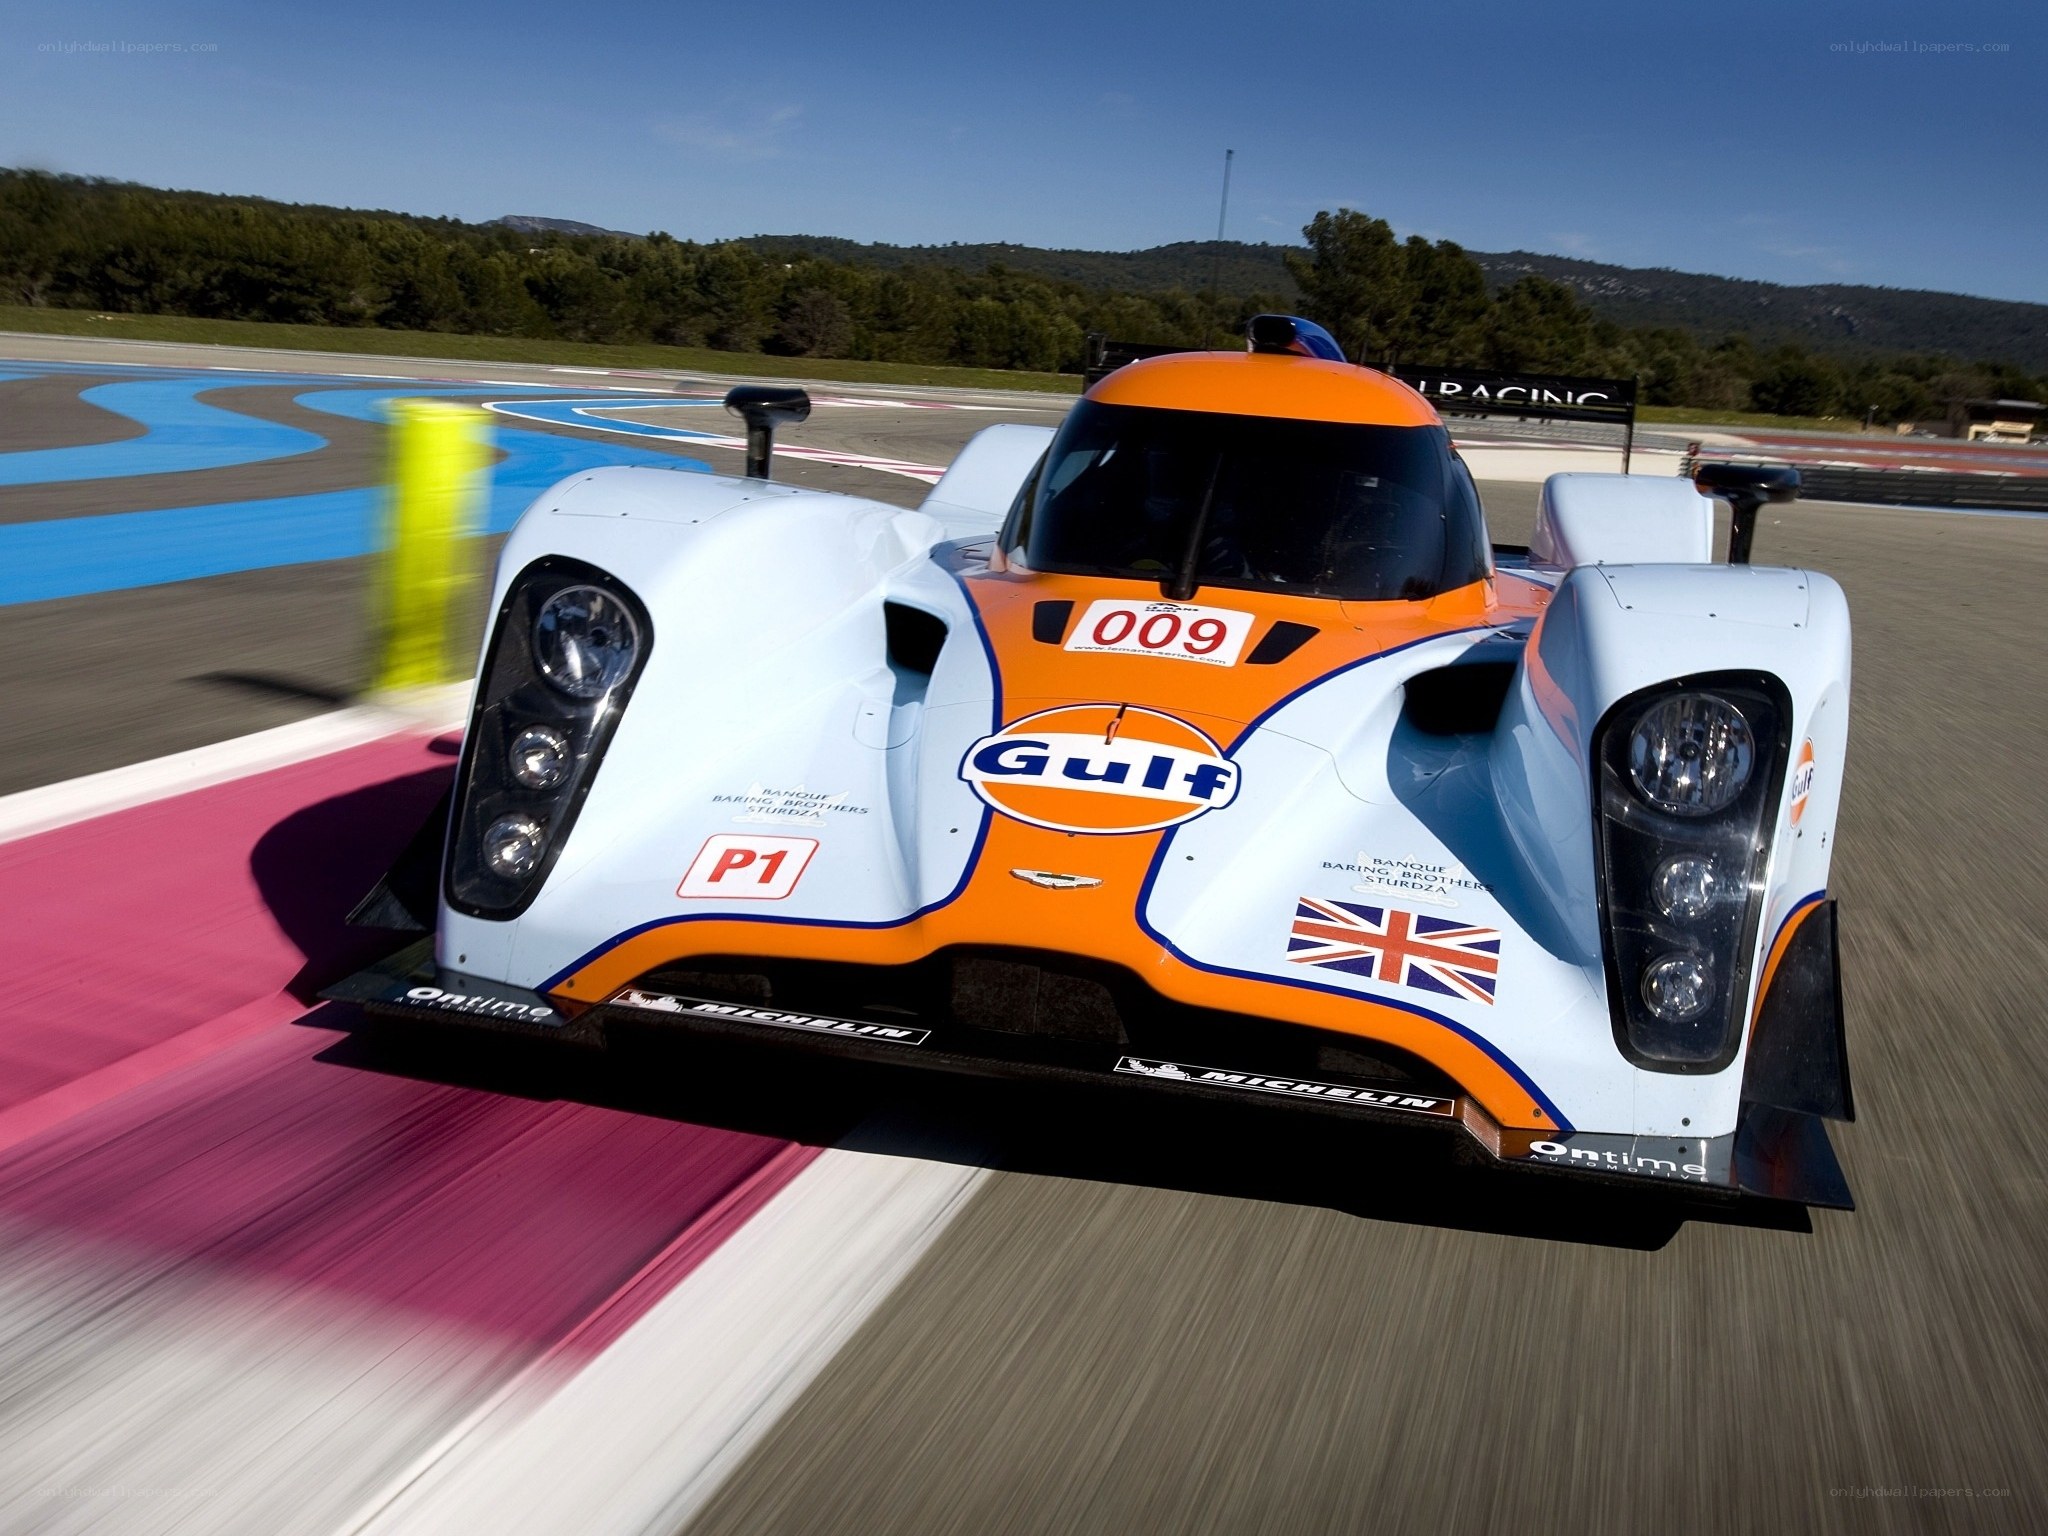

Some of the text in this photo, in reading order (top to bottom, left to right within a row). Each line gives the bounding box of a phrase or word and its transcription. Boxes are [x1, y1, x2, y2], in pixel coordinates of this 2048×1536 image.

[1093, 610, 1227, 654] 009
[1074, 645, 1226, 665] www.lemans-series.com
[973, 740, 1232, 800] Gulf
[1792, 767, 1814, 800] Gulf
[712, 795, 869, 814] BARING BROTHERS
[747, 806, 820, 818] STURDZA
[707, 848, 788, 884] P1
[1322, 861, 1495, 892] BARING BROTHERS
[1373, 858, 1447, 873] BANQUE
[1365, 875, 1447, 895] STURDZA
[692, 1003, 913, 1039] MICHELIN
[1200, 1071, 1437, 1109] MICHELIN
